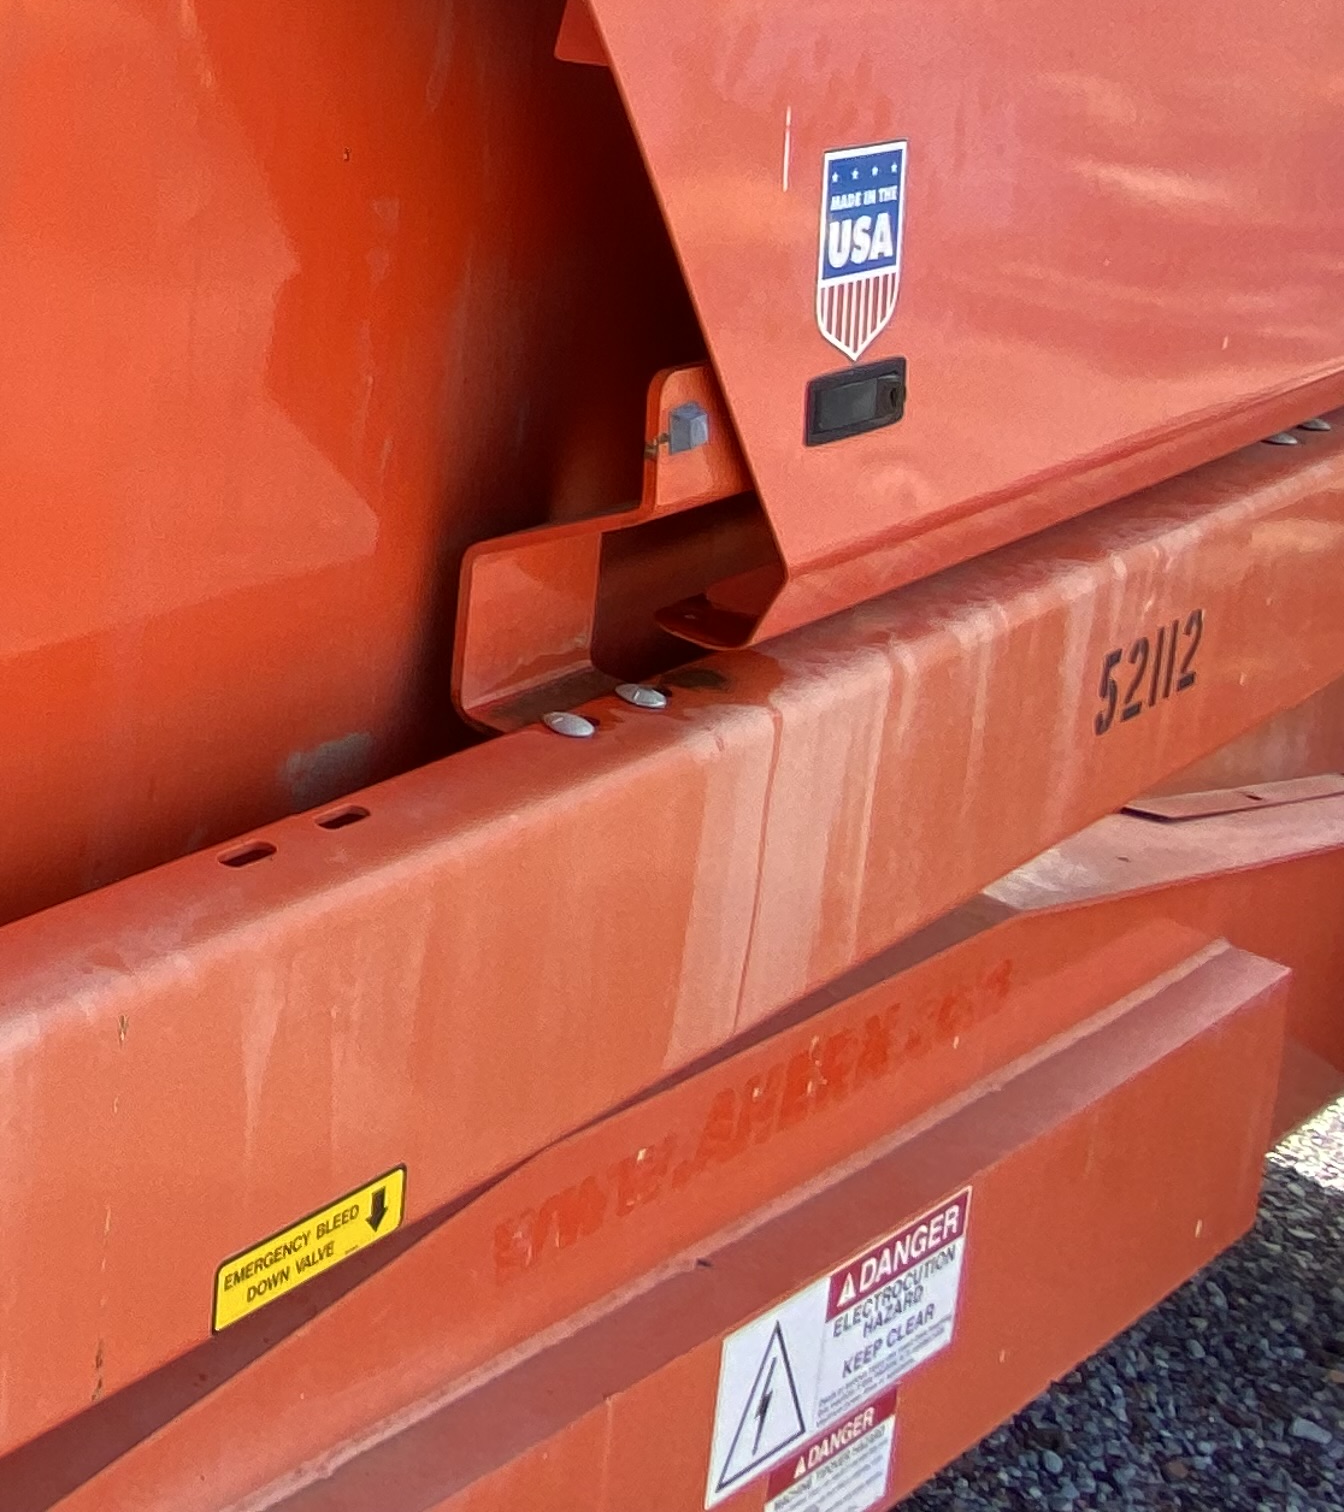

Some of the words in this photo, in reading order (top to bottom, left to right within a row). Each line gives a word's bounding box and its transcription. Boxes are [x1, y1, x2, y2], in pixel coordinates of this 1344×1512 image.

[830, 191, 862, 211] MADE
[863, 189, 877, 206] IN
[878, 185, 898, 203] THE
[828, 212, 893, 268] USA
[1094, 608, 1203, 736] 52112
[224, 1229, 312, 1292] EMERGENCY
[316, 1204, 360, 1240] BLEED
[246, 1266, 291, 1303] DOWN
[295, 1240, 336, 1274] VALVE
[859, 1204, 961, 1293] DANGER
[832, 1244, 956, 1338] ELECTROCUTION
[863, 1284, 925, 1338] HAZARD
[842, 1334, 884, 1378] KEEP
[886, 1303, 936, 1348] CLEAR
[807, 1406, 875, 1470] DANGER
